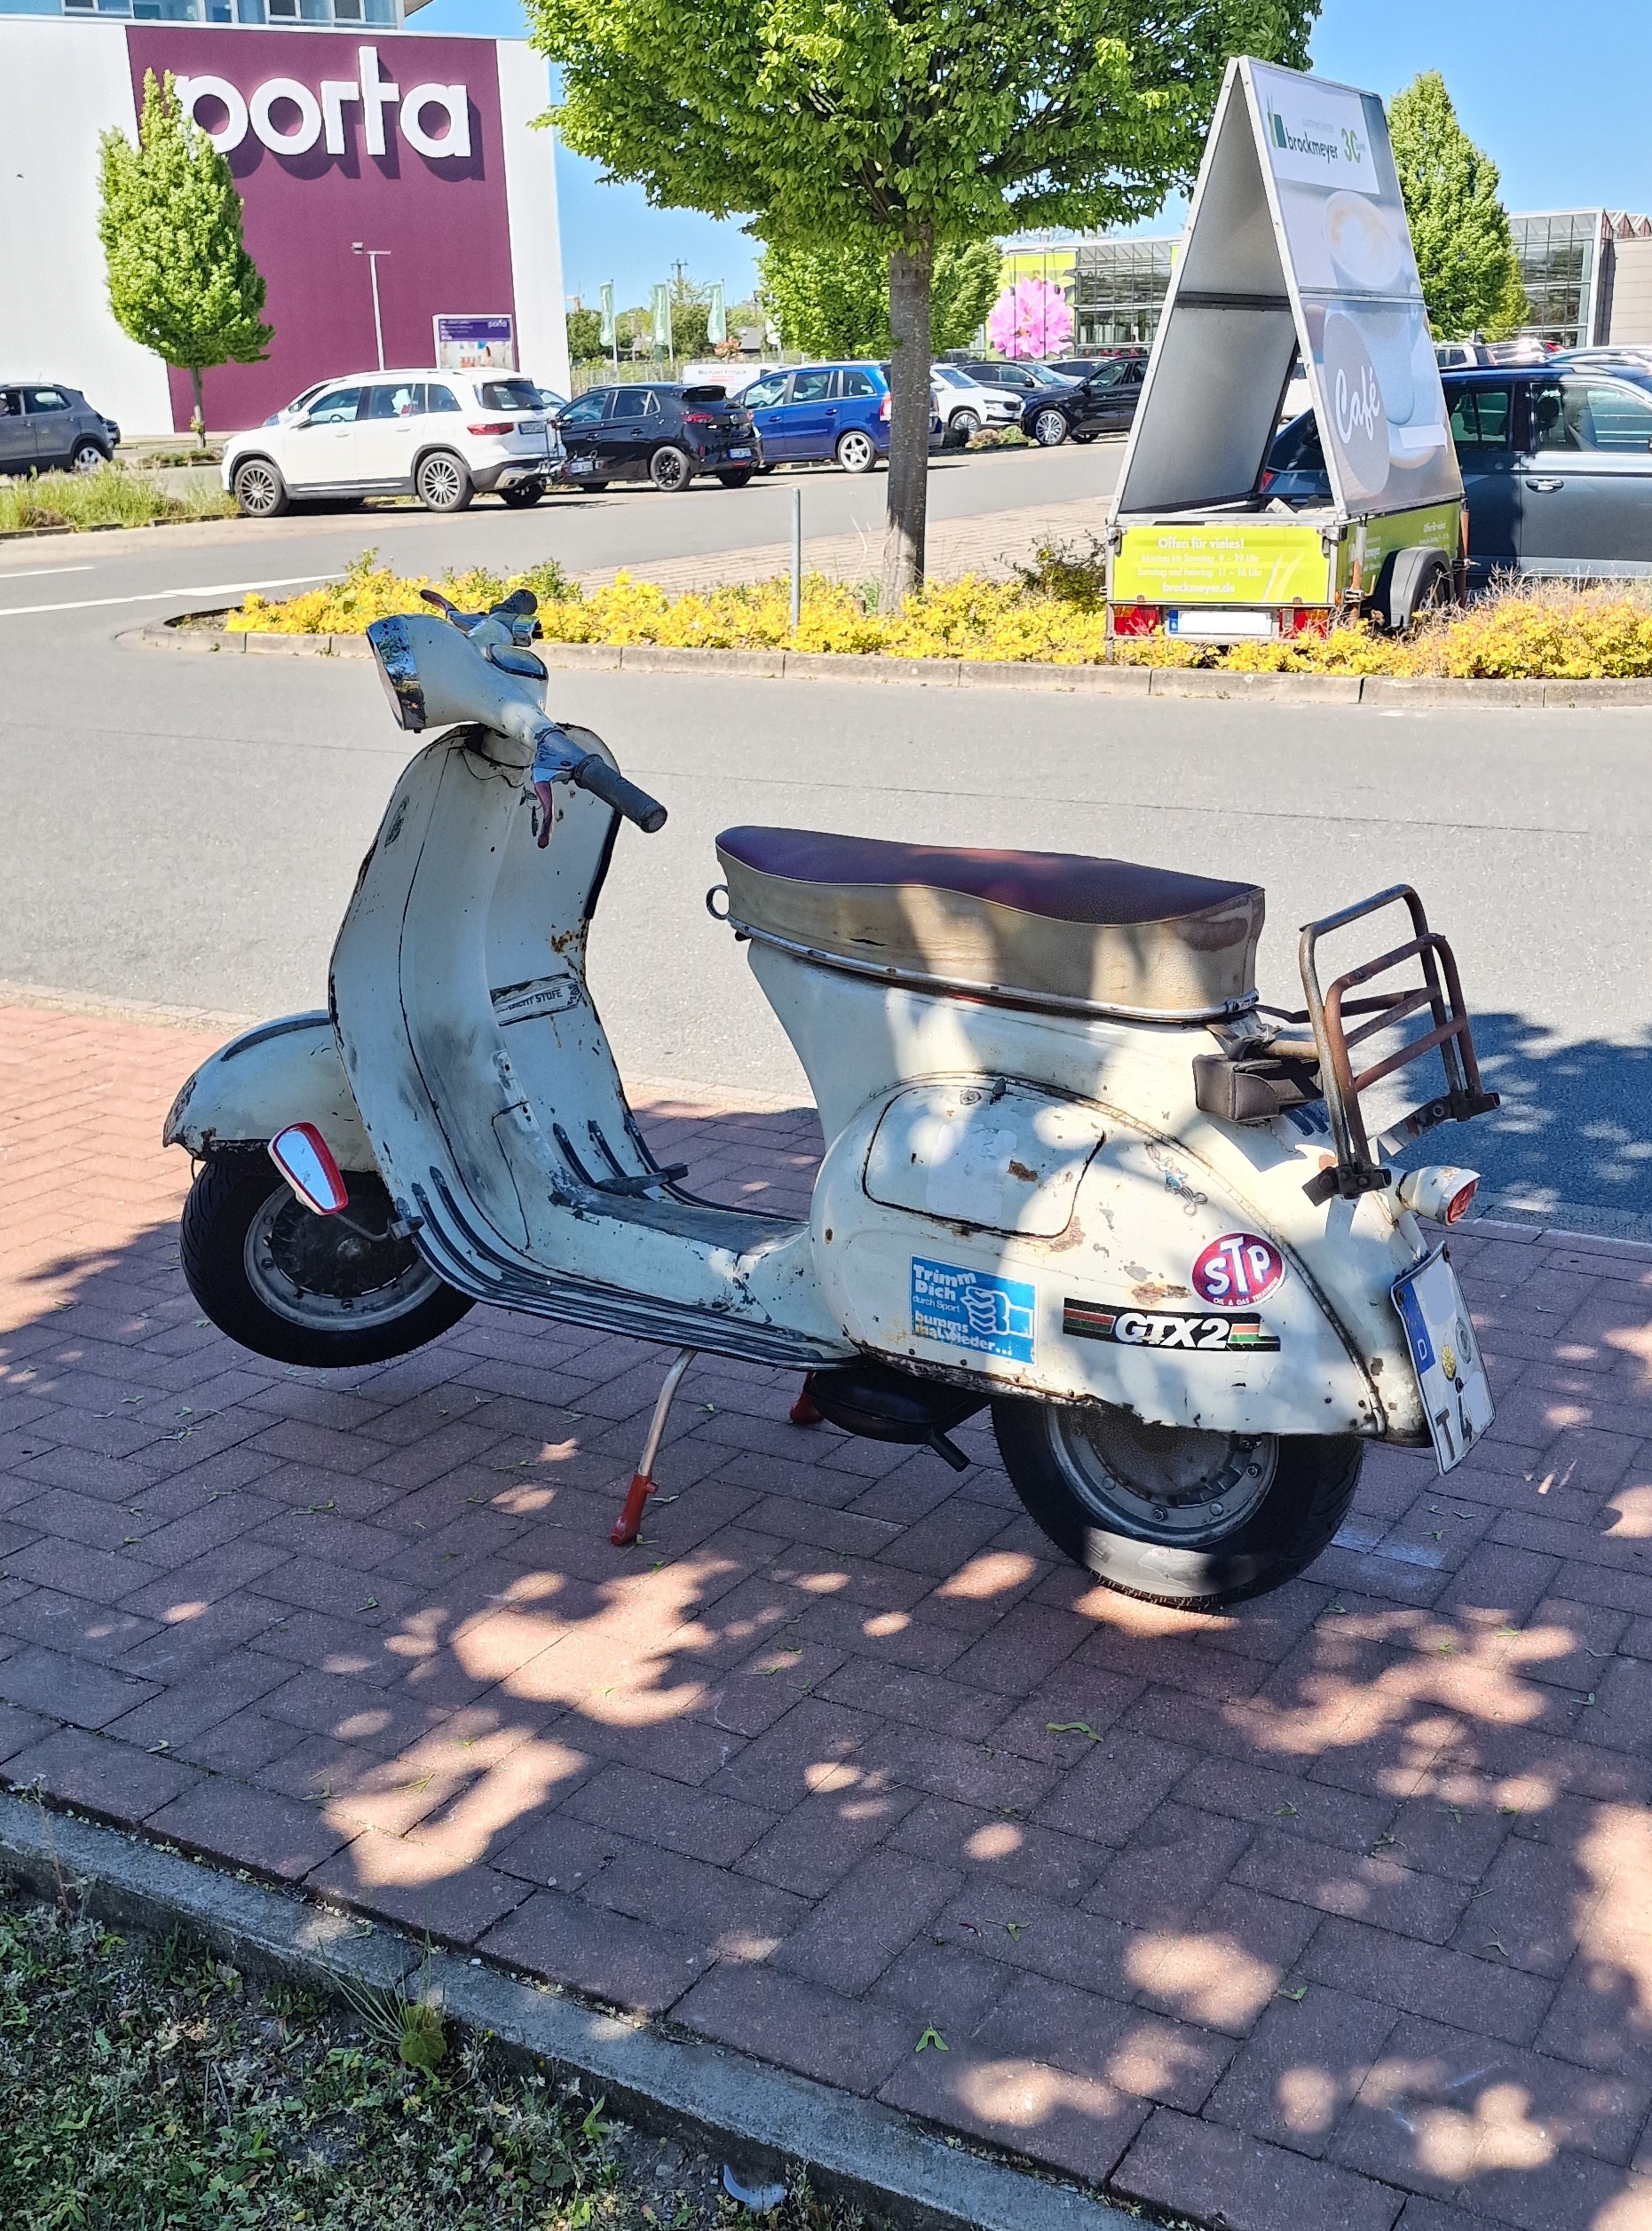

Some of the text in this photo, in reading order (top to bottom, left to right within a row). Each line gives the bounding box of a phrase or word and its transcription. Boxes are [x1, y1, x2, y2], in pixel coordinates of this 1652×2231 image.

[173, 45, 471, 159] porta
[1285, 127, 1339, 163] brockmeyer
[1335, 366, 1379, 444] Café
[1158, 537, 1245, 550] Offen für vieles!
[913, 1264, 976, 1287] Trimm
[1205, 1237, 1270, 1295] STP
[915, 1279, 956, 1301] Dich
[913, 1295, 960, 1312] durch Sport
[914, 1310, 969, 1333] bumms
[1114, 1312, 1229, 1349] GTX2
[1417, 1338, 1427, 1361] D
